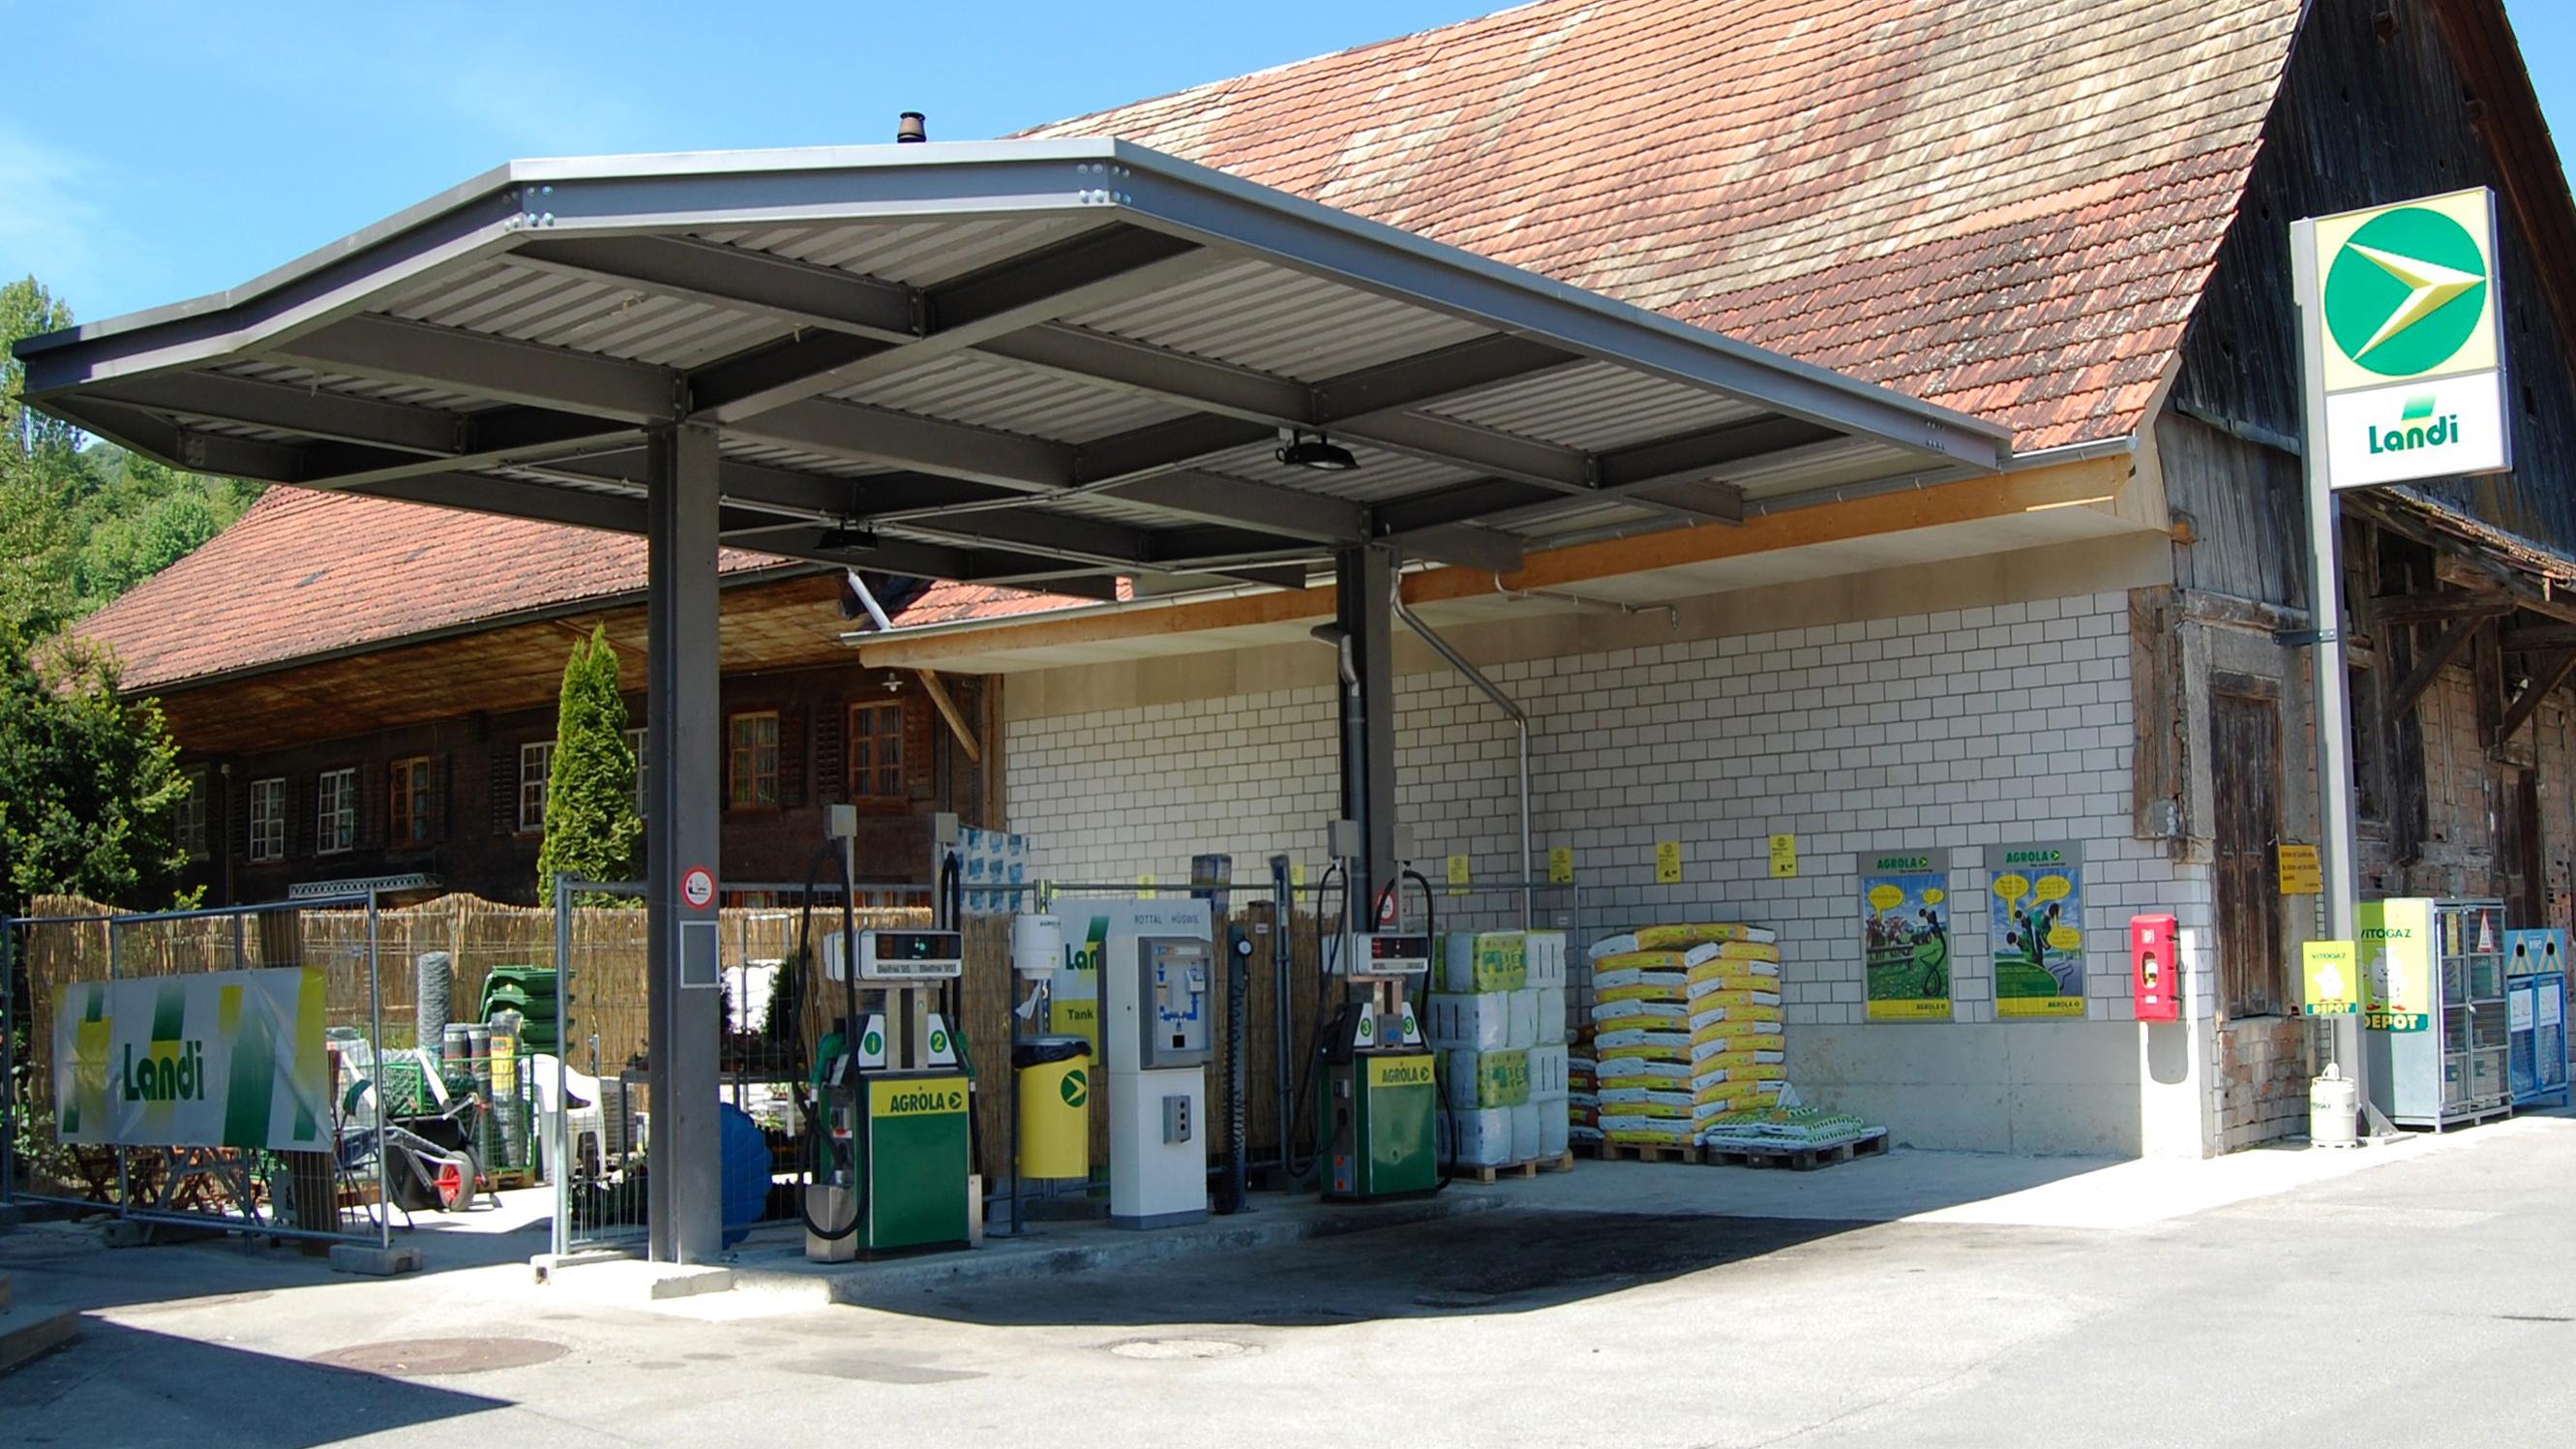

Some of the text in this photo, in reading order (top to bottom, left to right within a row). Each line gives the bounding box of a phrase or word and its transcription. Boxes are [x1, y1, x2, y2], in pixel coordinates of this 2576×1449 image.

[2368, 414, 2458, 454] Landi
[1876, 858, 1918, 869] AGROLA
[2006, 852, 2049, 863] AGROLA
[1133, 915, 1163, 924] ROTTAL
[1065, 943, 1098, 971] Lan
[1067, 1009, 1093, 1020] Tank
[932, 1032, 944, 1051] 2
[123, 1040, 204, 1102] Landi
[1382, 1067, 1420, 1083] AGROLA
[890, 1093, 945, 1113] AGROLA
